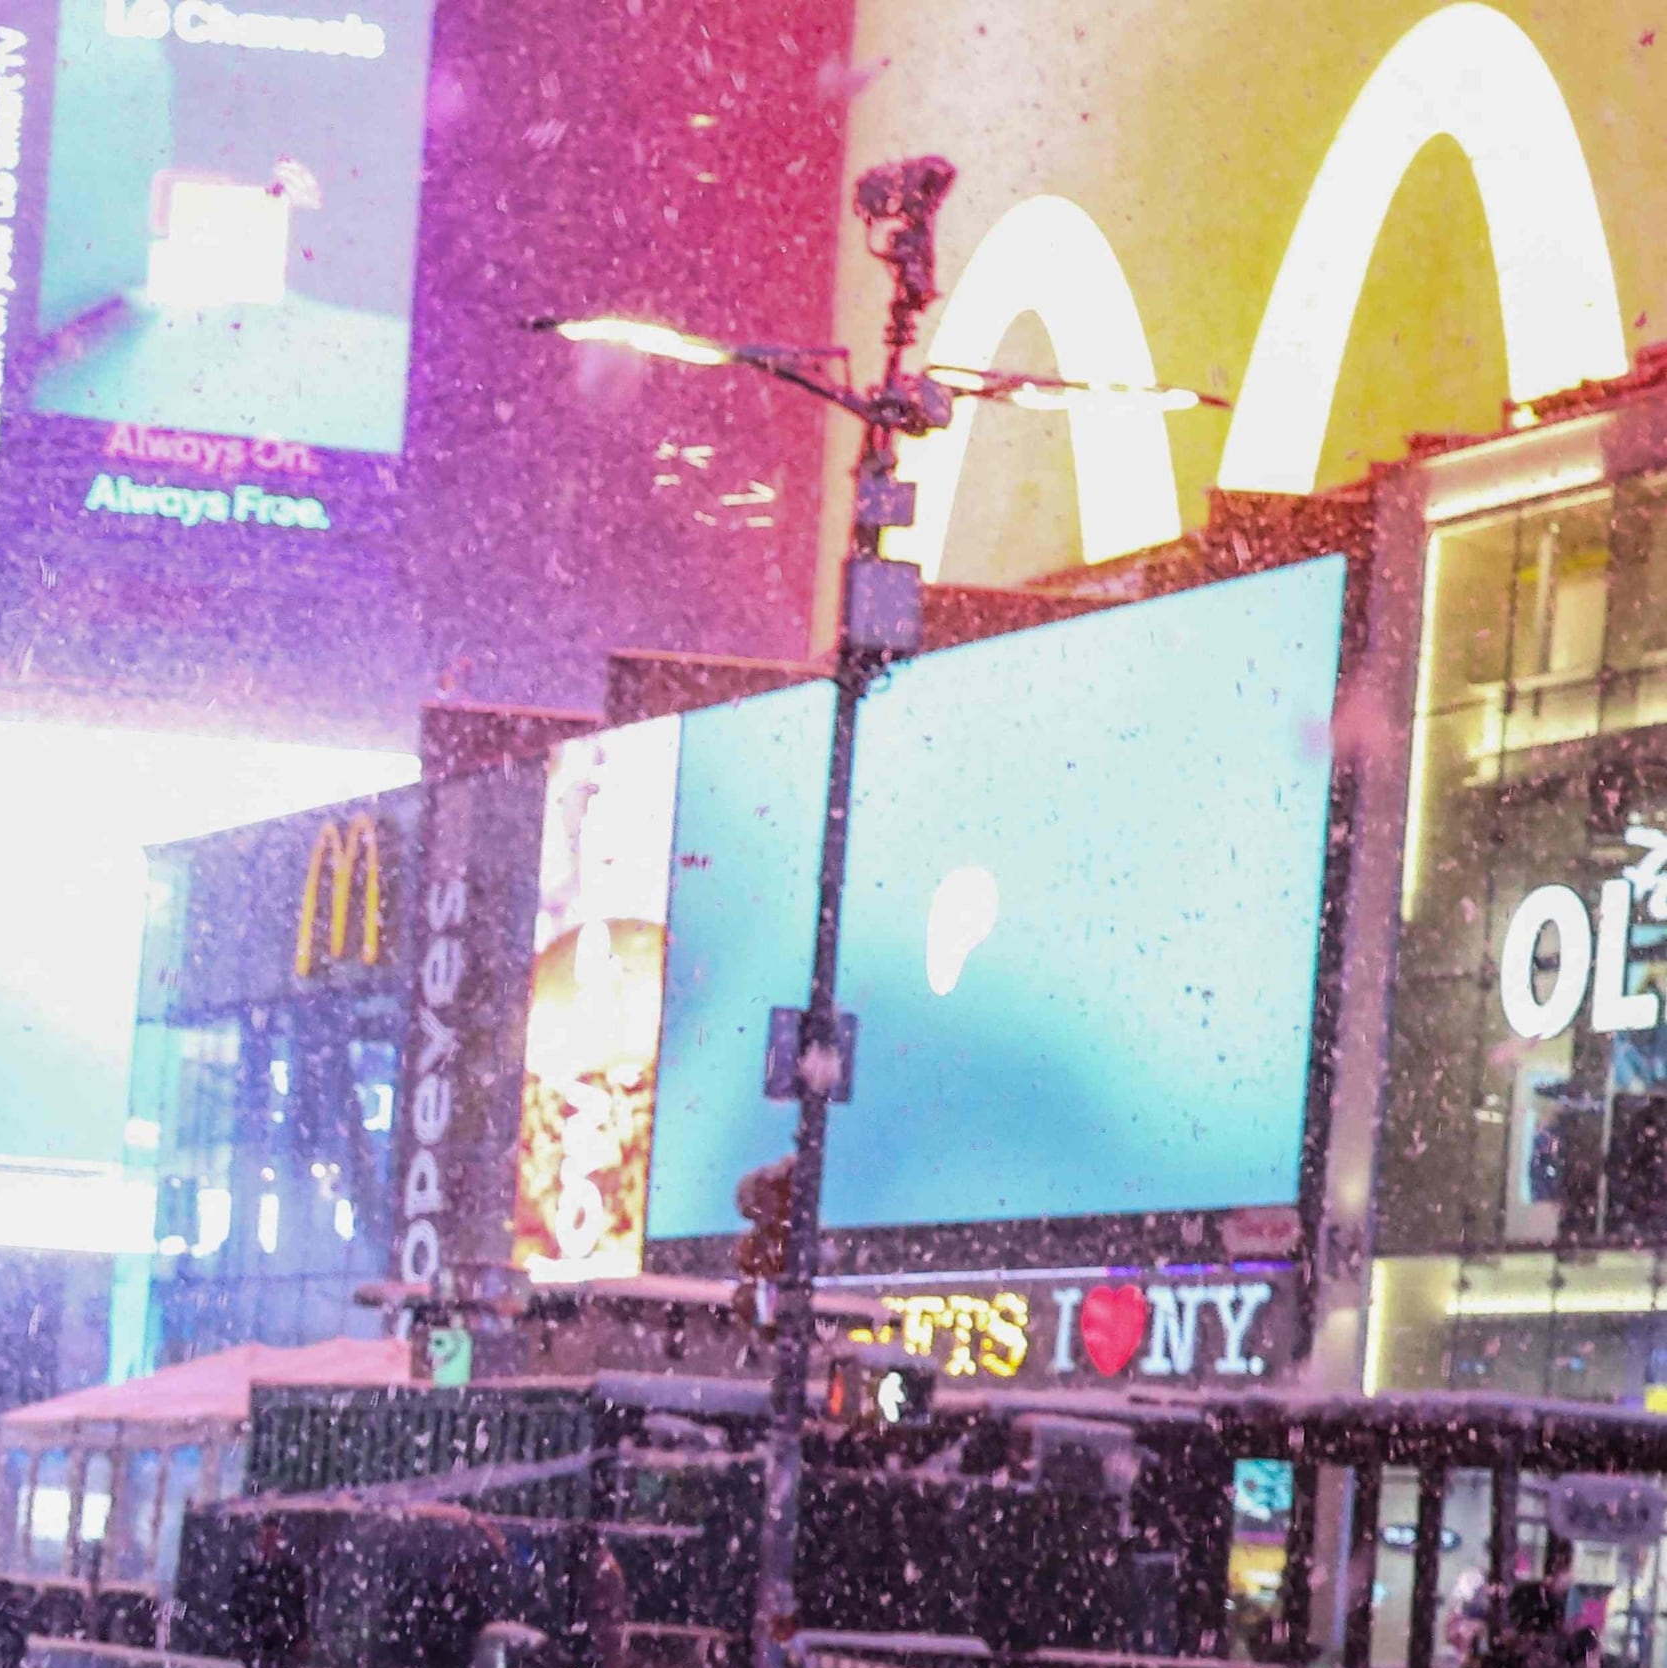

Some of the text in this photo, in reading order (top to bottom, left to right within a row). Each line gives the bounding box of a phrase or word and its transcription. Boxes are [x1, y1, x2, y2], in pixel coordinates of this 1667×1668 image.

[103, 424, 247, 482] Always
[85, 473, 330, 530] Always Free.
[1501, 878, 1667, 1040] OL
